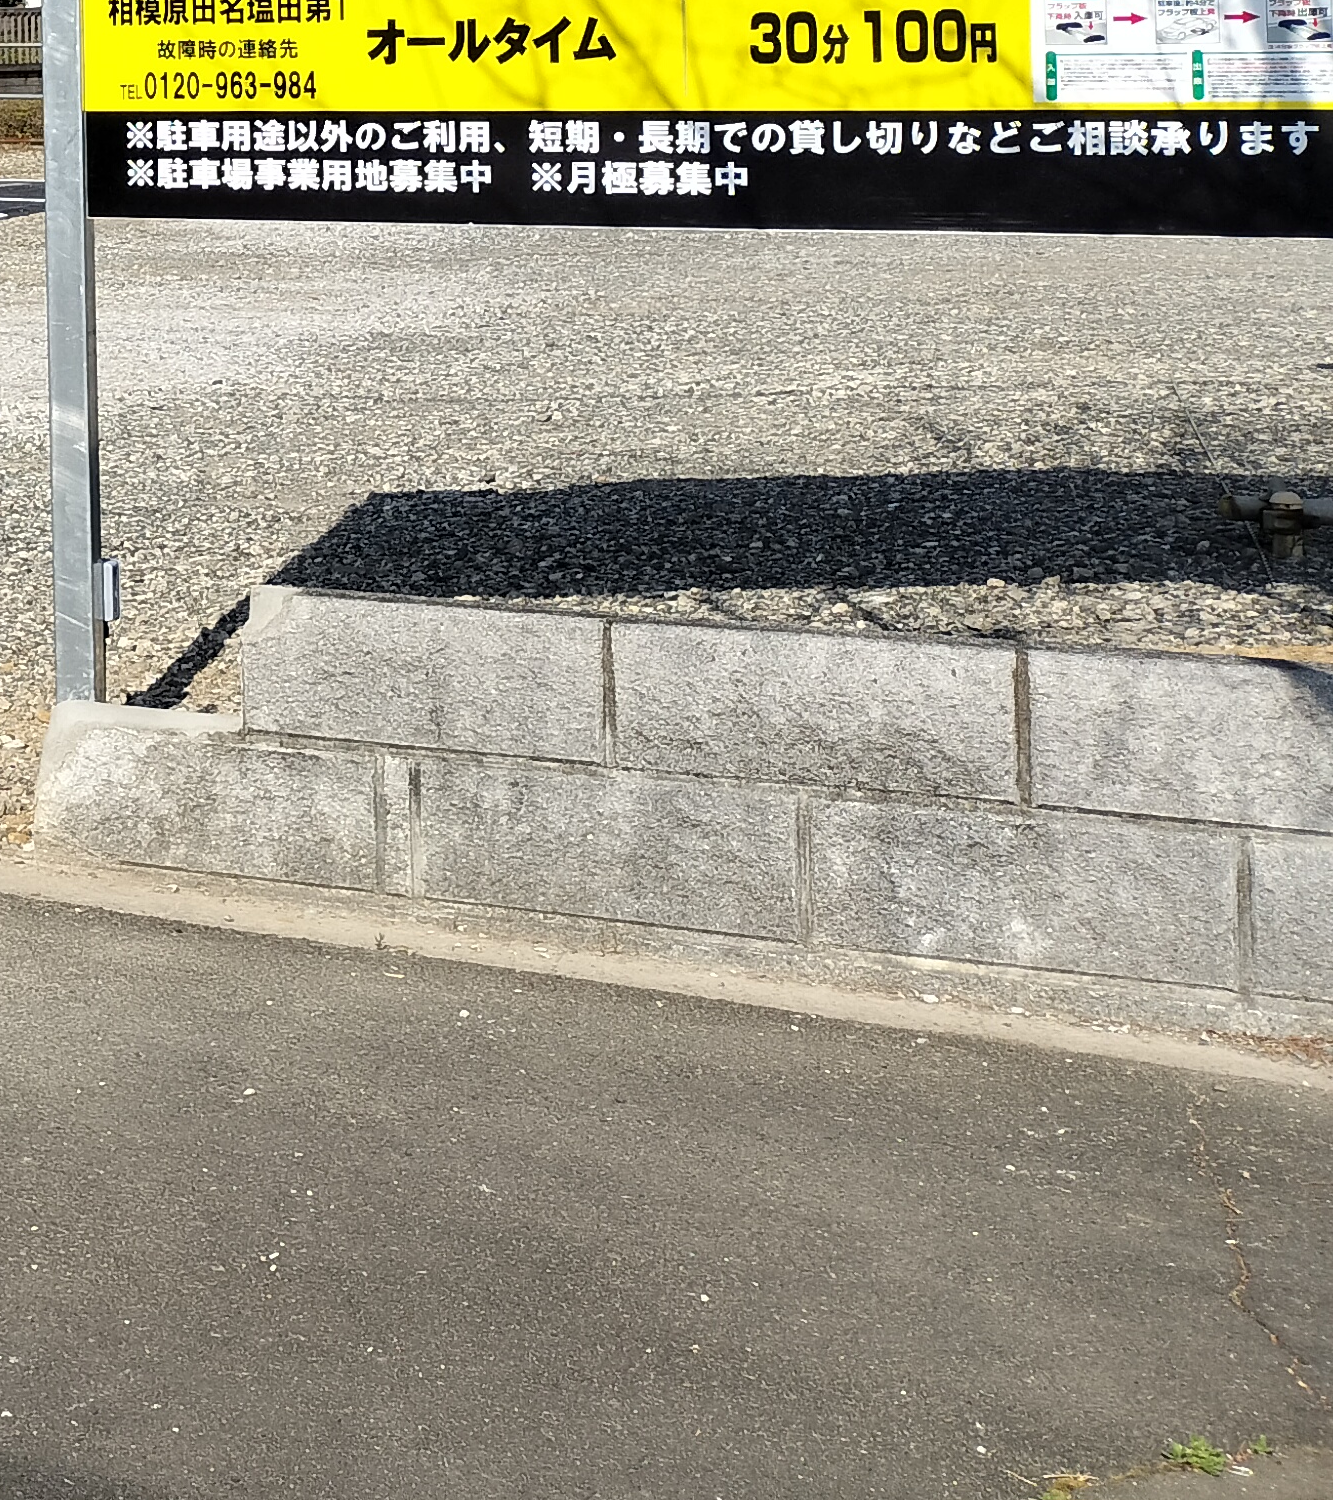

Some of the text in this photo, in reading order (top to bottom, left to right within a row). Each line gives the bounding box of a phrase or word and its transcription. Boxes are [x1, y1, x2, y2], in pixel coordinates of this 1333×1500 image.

[157, 38, 299, 60] 故障時の連絡先
[367, 15, 617, 65] オールタイム
[528, 119, 1320, 157] 短期・長期での貸し切りなどご相談承ります
[126, 158, 749, 196] ※駐車場事業用地募集中 ※月極募集中
